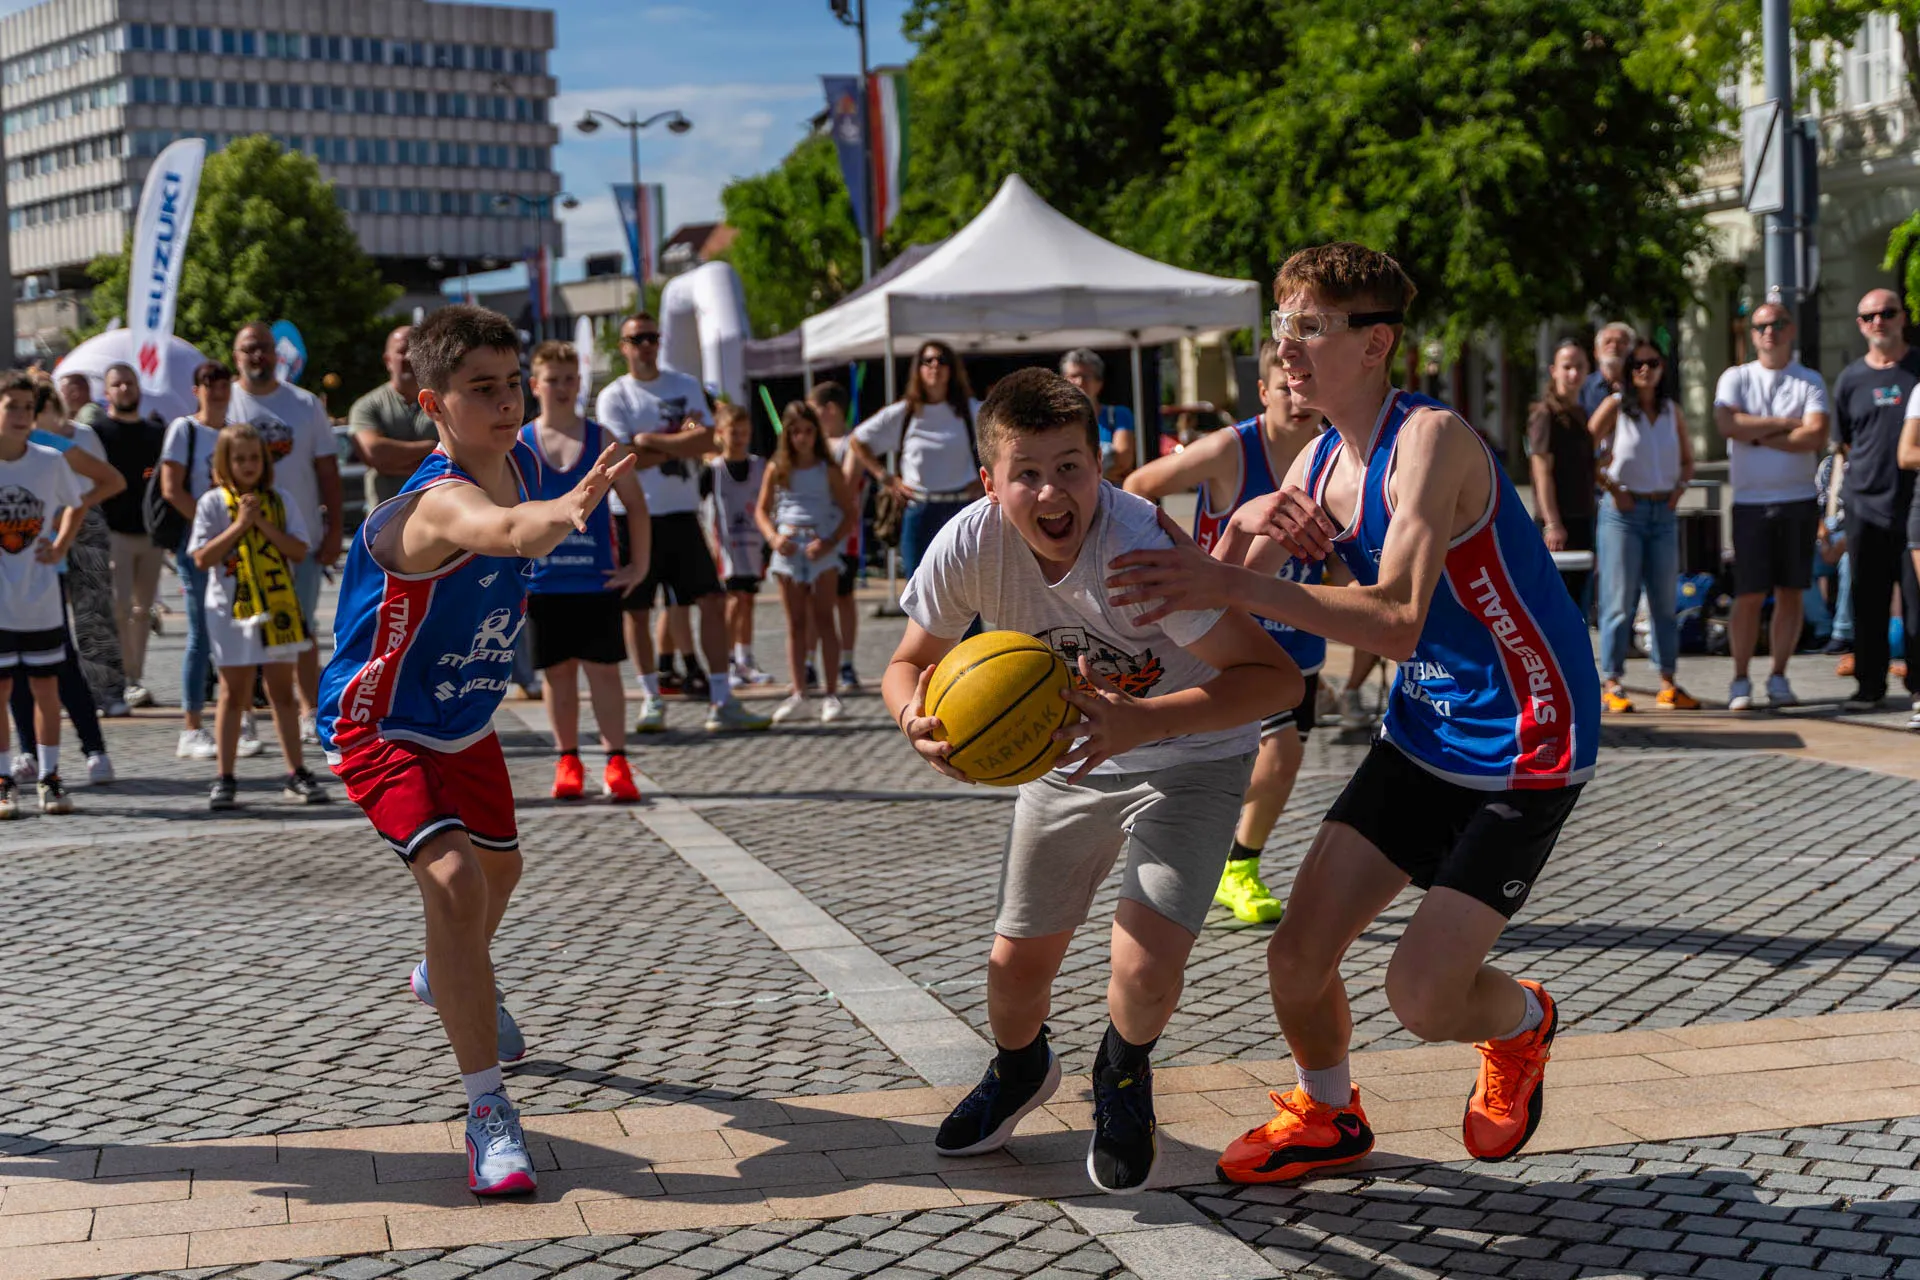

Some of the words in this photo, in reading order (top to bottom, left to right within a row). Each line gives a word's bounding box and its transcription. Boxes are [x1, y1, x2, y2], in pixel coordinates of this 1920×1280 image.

[146, 170, 182, 329] SUZUKI
[1469, 566, 1557, 725] STREETBALL
[973, 704, 1058, 771] TARMAK
